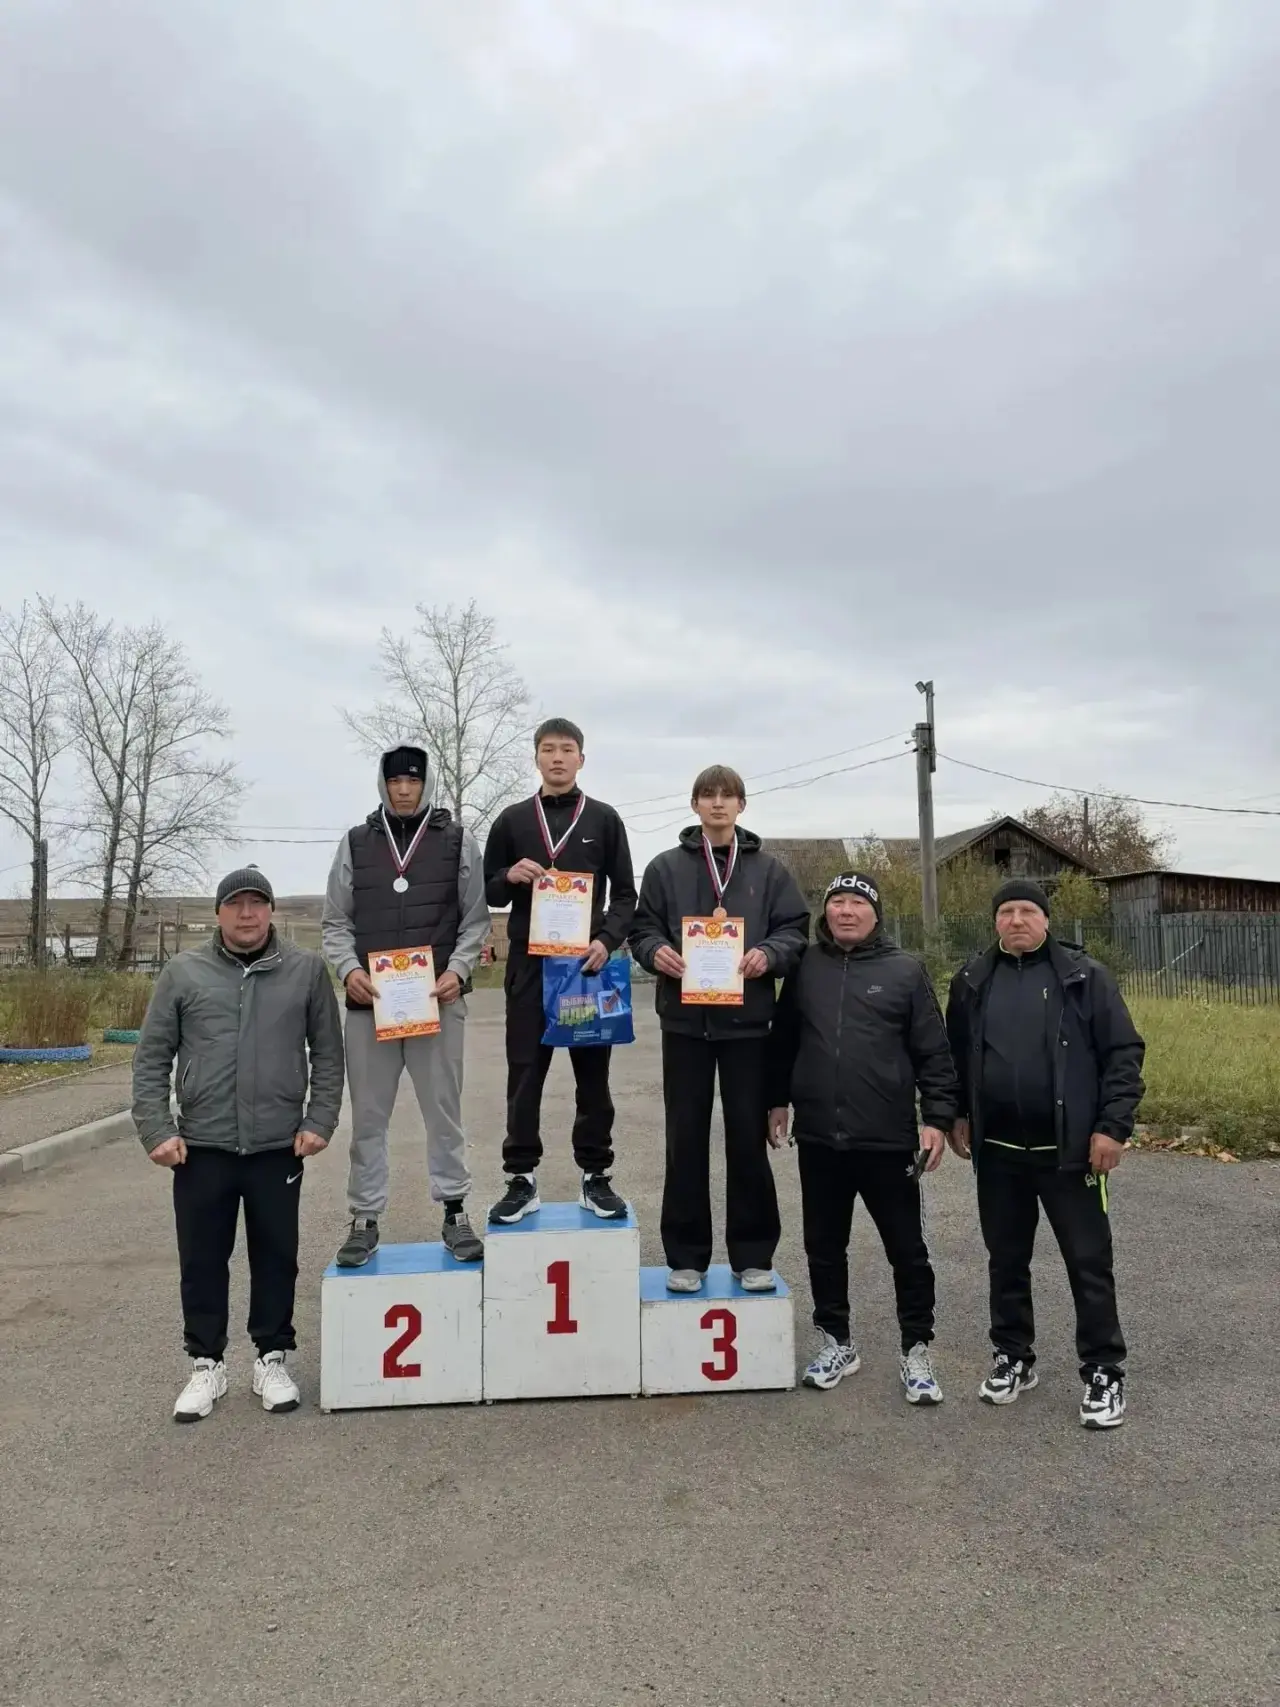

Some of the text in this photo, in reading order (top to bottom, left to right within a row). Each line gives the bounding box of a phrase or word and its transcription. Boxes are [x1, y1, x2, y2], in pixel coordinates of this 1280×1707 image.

[547, 1261, 577, 1334] 1
[383, 1304, 421, 1377] 2
[700, 1308, 738, 1381] 3
